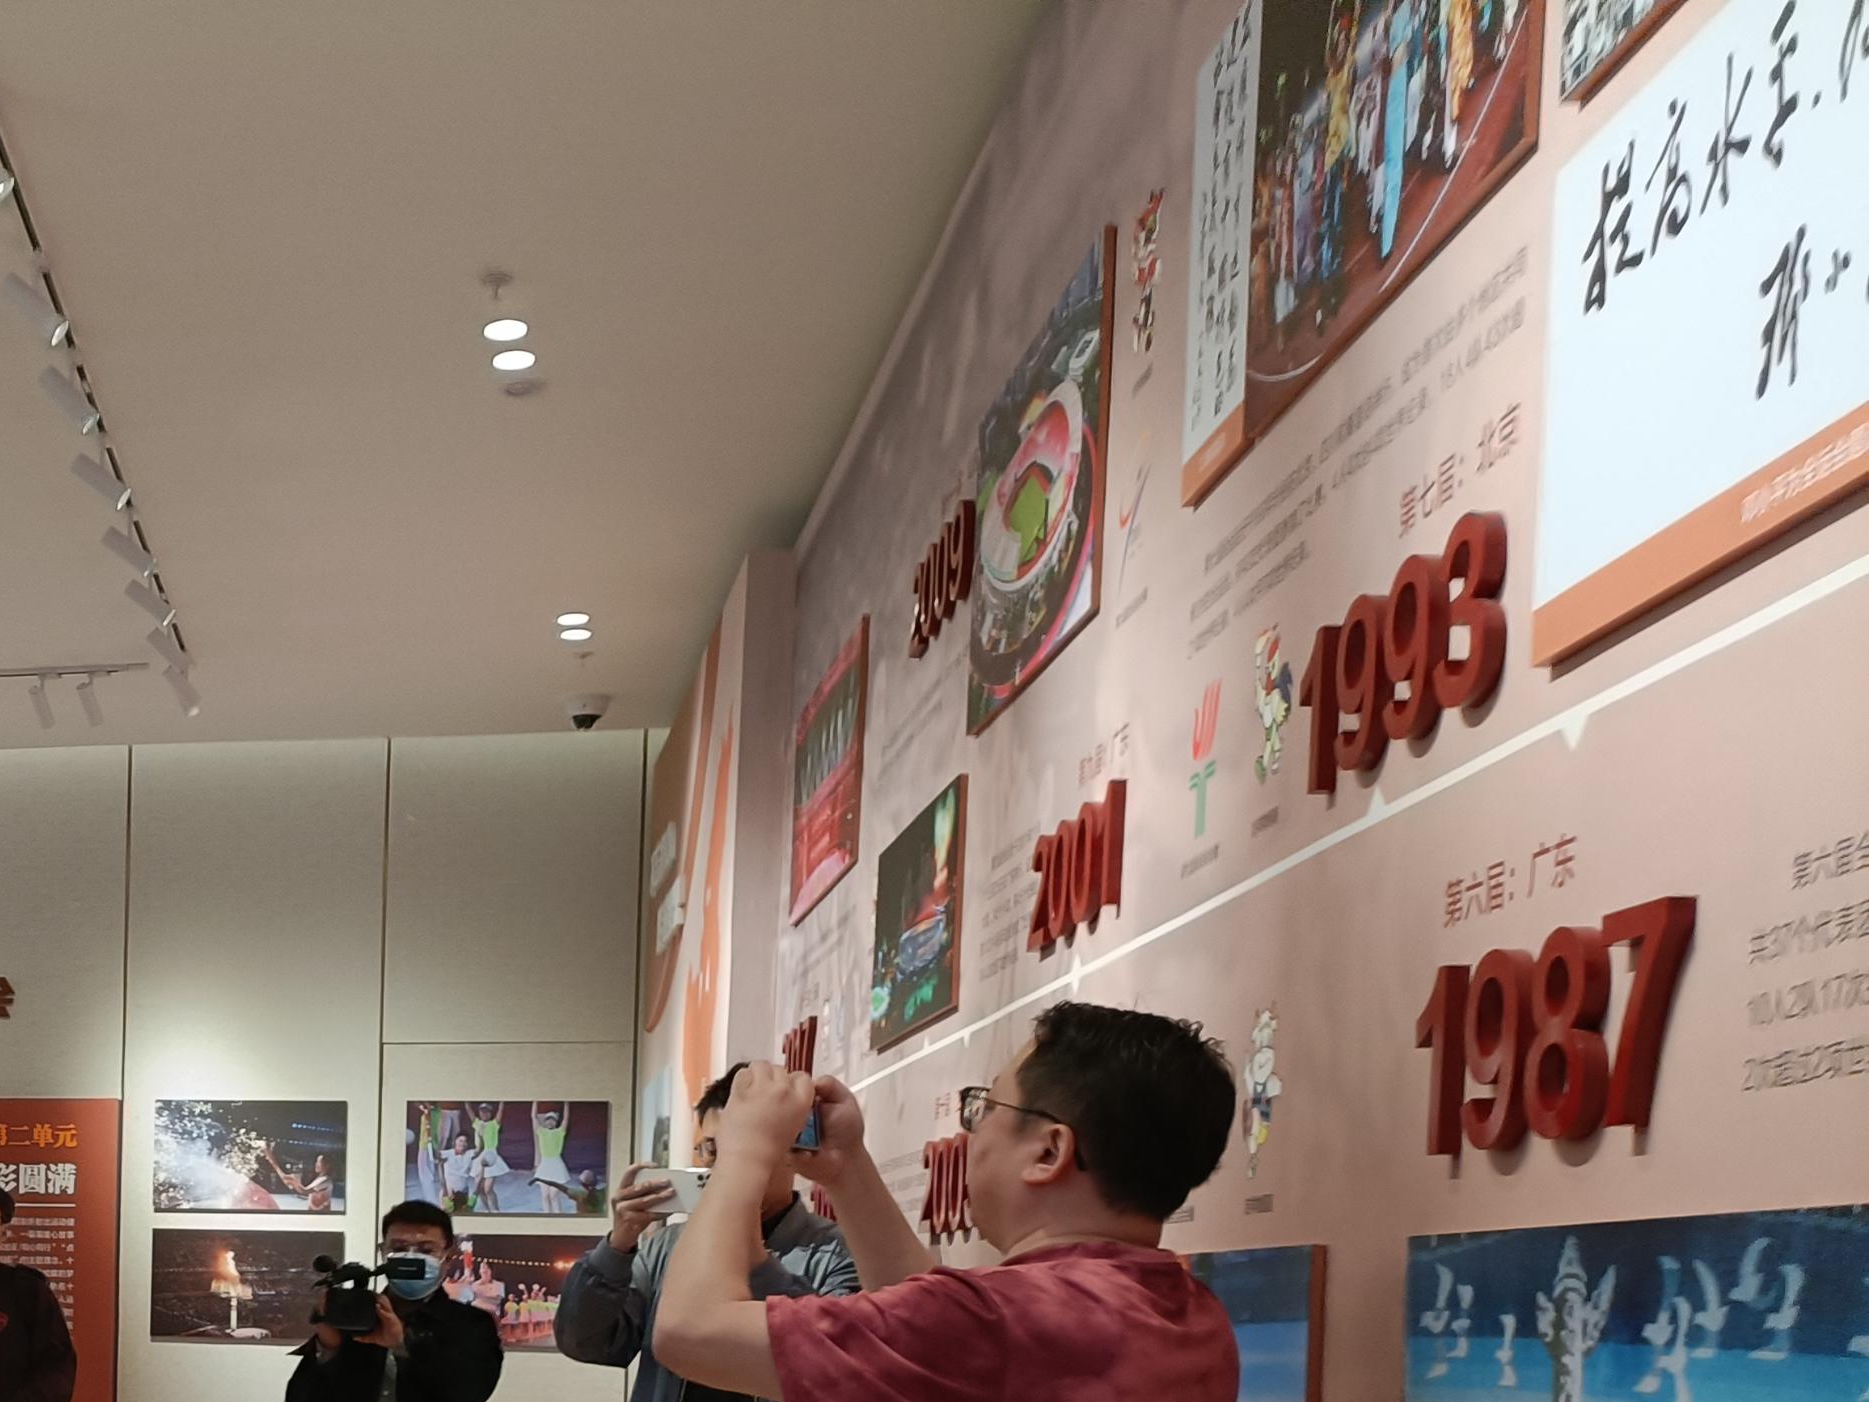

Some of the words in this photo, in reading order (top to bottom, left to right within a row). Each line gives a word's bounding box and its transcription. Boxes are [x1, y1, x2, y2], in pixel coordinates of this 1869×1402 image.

[908, 500, 976, 659] 2009
[1299, 510, 1508, 795] 1993
[1026, 778, 1128, 953] 2001
[1415, 894, 1700, 1156] 1987
[920, 1132, 973, 1234] 200
